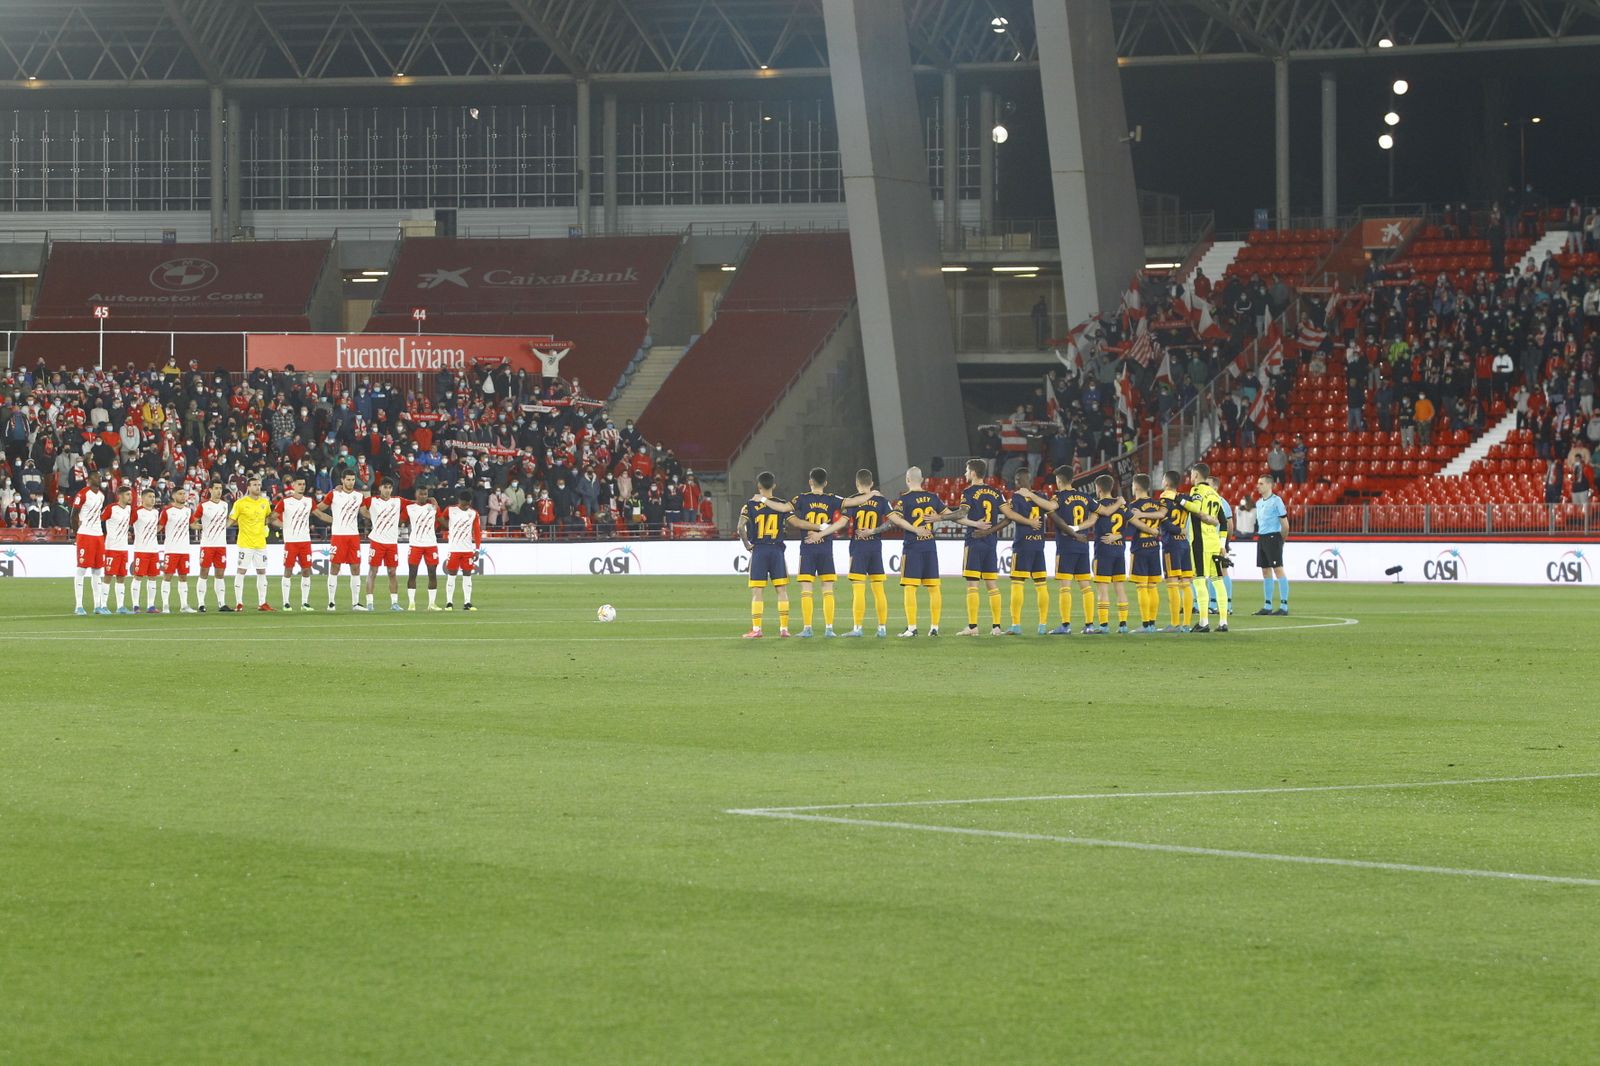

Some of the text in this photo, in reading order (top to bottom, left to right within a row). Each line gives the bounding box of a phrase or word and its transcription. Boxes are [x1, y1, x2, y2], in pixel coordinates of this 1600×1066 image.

[482, 267, 640, 285] CaixaBank
[88, 292, 264, 302] Automotor Costa
[94, 306, 109, 318] 45
[413, 309, 426, 320] 44
[336, 336, 465, 369] FuenteLiviana
[754, 514, 779, 539] 14
[856, 510, 878, 530] 10
[1111, 513, 1123, 535] 2
[79, 548, 85, 557] 9
[589, 556, 630, 575] CASI
[1306, 558, 1338, 579] CASI
[1423, 560, 1458, 580] CASI
[1546, 561, 1582, 582] CASI
